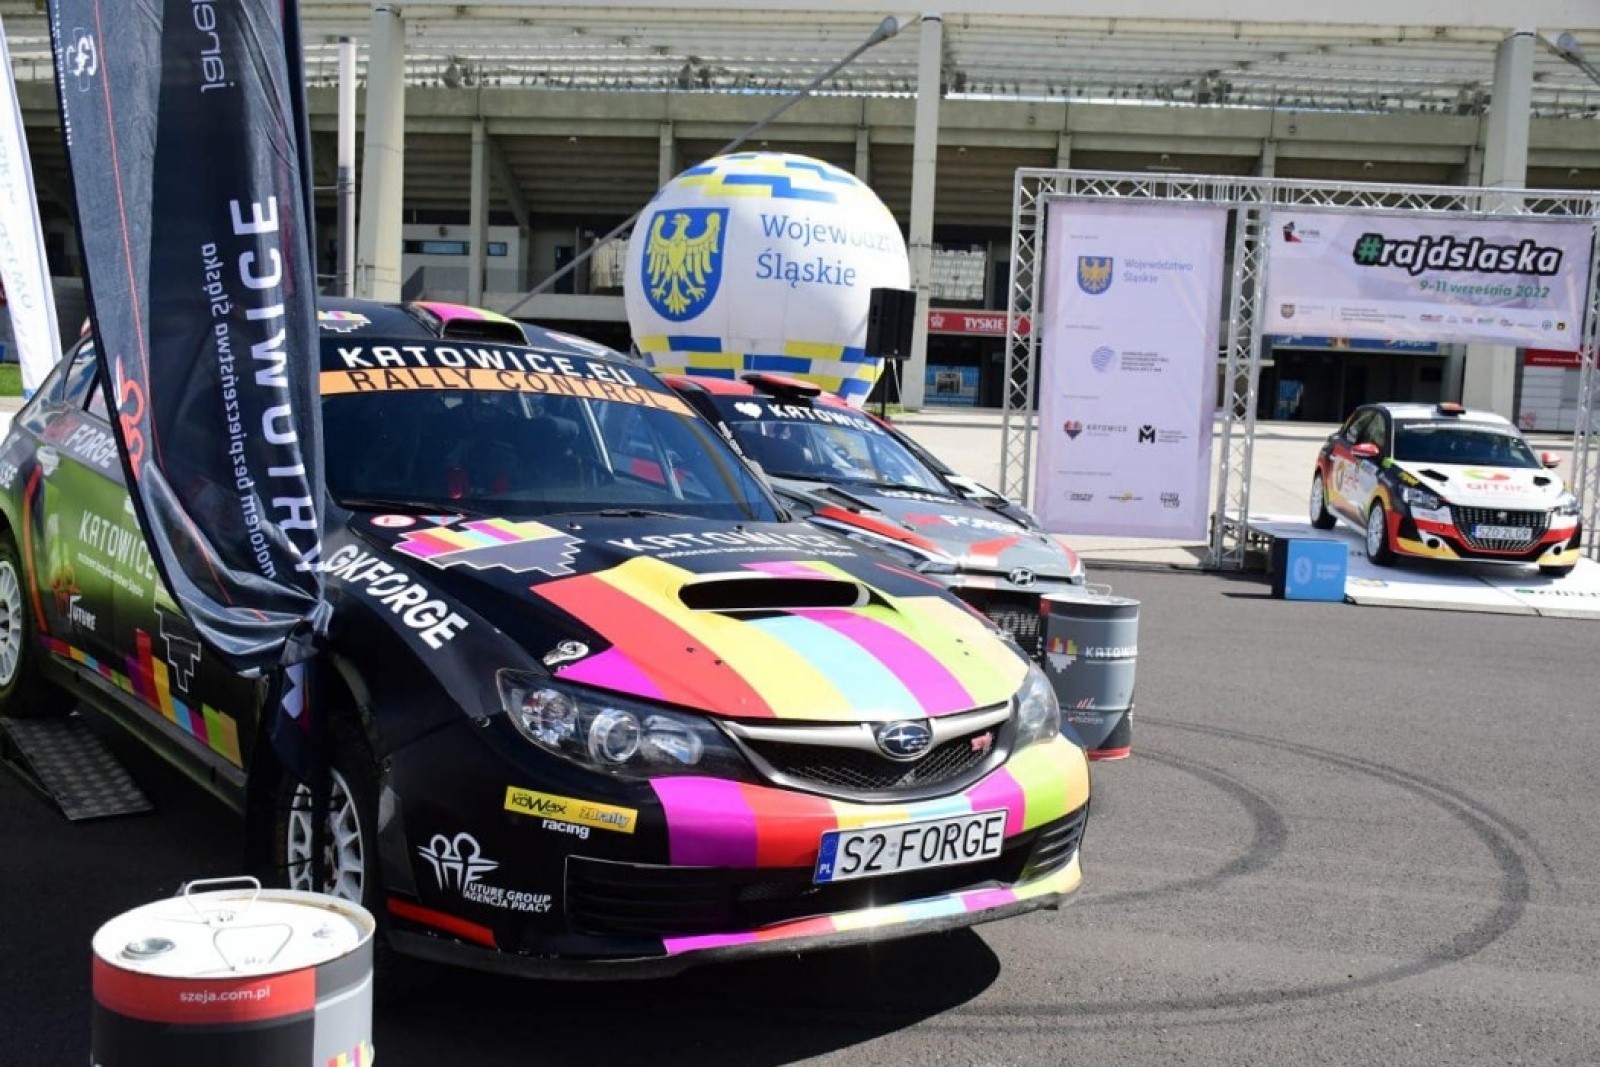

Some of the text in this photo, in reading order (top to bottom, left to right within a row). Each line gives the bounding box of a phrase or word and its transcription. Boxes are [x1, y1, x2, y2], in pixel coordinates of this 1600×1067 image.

[1356, 234, 1561, 276] #rajdslaska
[756, 249, 856, 288] Śląskie
[1419, 280, 1447, 292] 9-11
[1515, 285, 1551, 299] 2022
[963, 317, 1005, 330] TYSKIE
[338, 346, 637, 387] KATOWICE.EU
[348, 370, 665, 409] RALLY CONTROL
[606, 531, 853, 552] KATOWICE
[542, 819, 590, 839] racing
[842, 816, 1003, 874] S2 FORGE
[819, 864, 832, 875] PL
[506, 890, 551, 904] GROUP
[510, 902, 552, 913] PRACY
[179, 985, 272, 1004] szeja.com.pl
